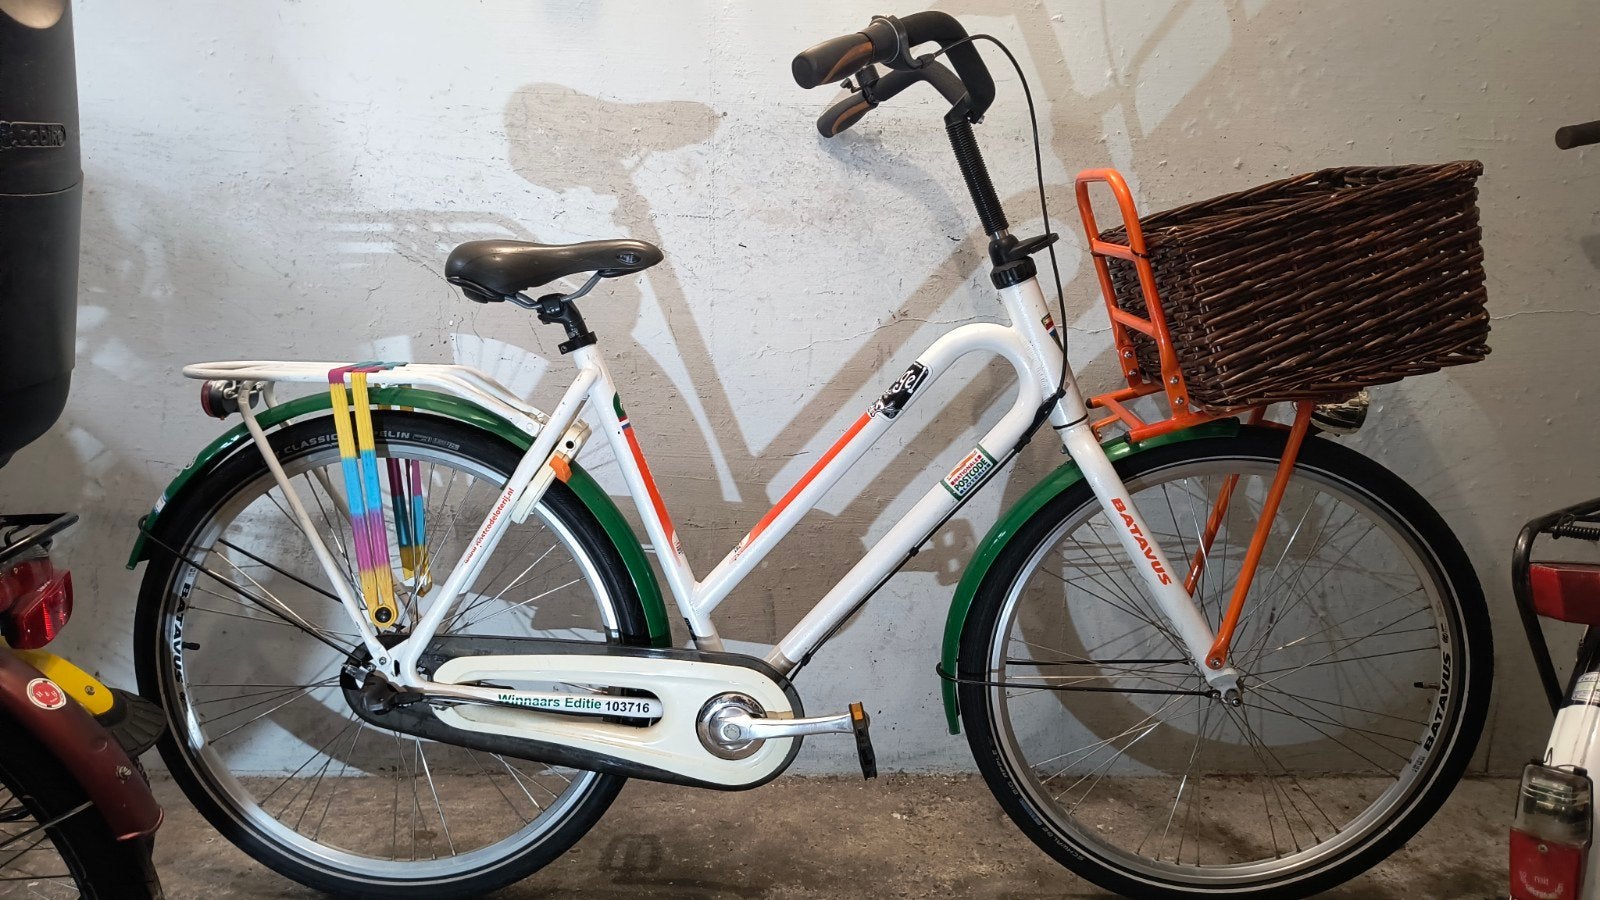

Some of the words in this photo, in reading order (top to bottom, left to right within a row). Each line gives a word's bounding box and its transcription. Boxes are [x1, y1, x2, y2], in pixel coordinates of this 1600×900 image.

[953, 458, 988, 491] POSTCODE
[1111, 497, 1173, 585] BATAVUS
[173, 583, 191, 683] BATAVUS
[498, 694, 560, 708] Winnaars
[565, 697, 602, 709] Editie
[605, 701, 650, 713] 103716
[1423, 651, 1451, 752] BATAVUS
